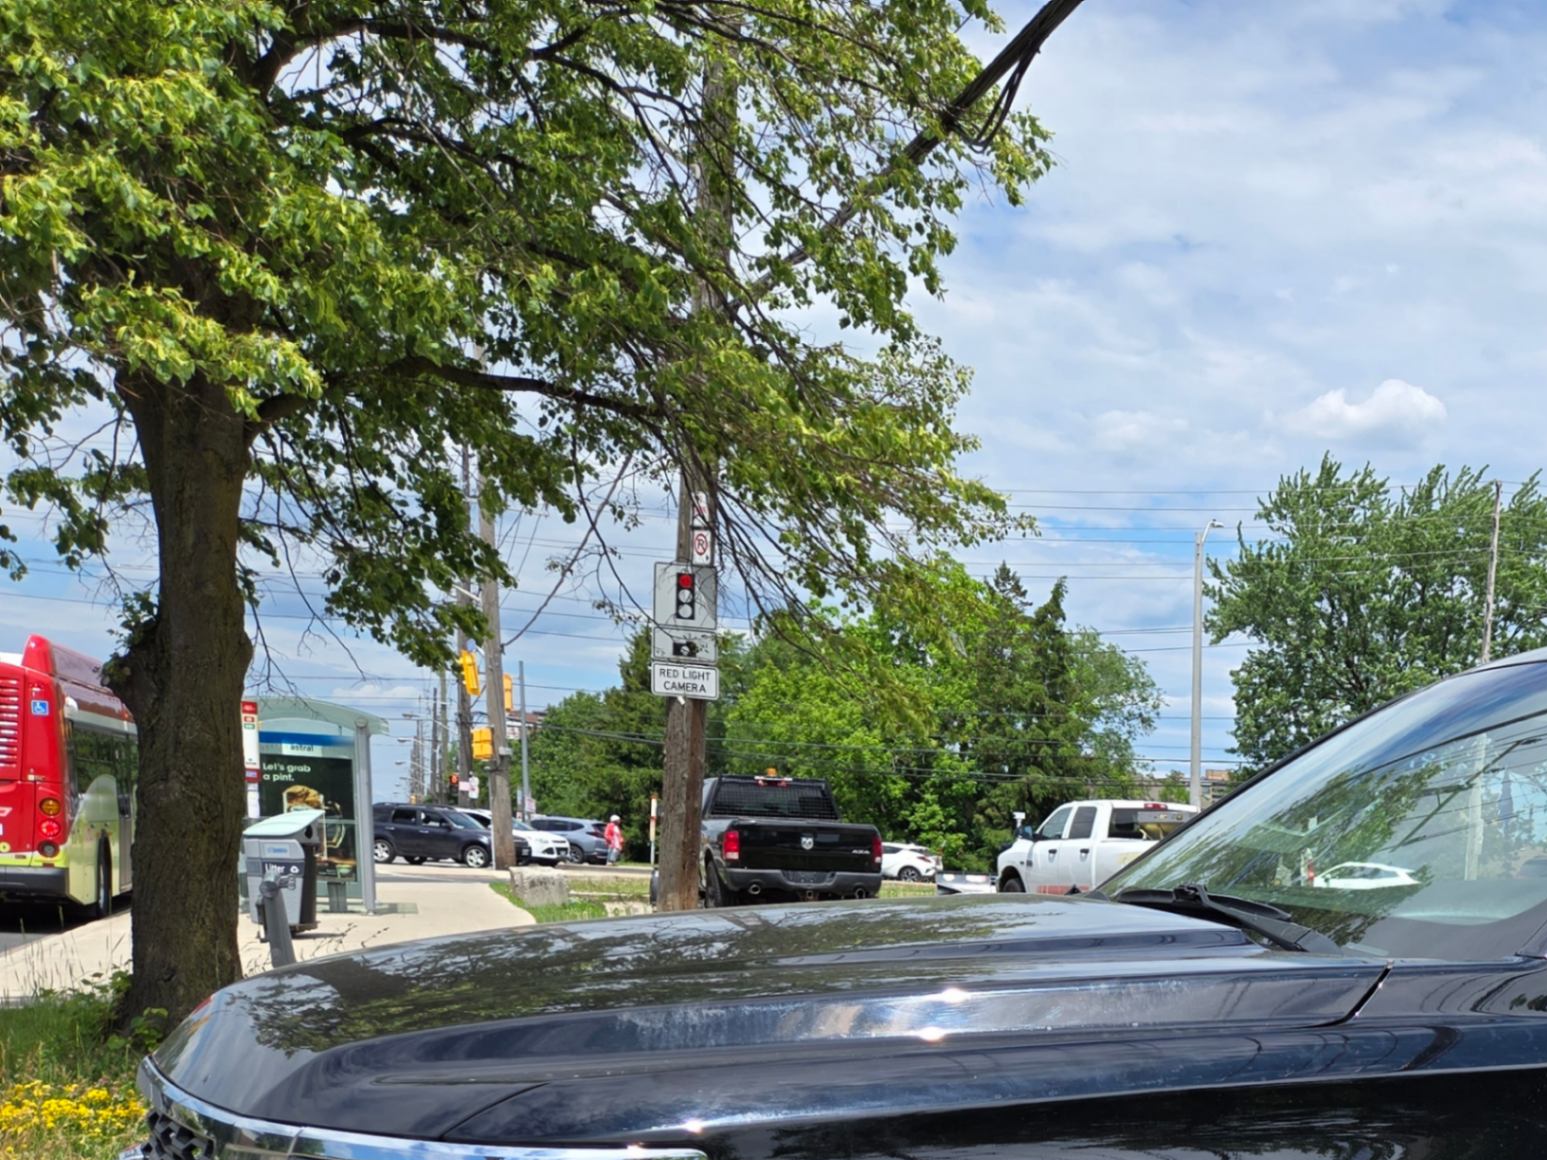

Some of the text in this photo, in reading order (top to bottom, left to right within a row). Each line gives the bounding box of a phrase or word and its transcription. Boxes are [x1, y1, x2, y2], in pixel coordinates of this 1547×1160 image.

[659, 668, 711, 681] RED LIGHT
[663, 681, 706, 693] CAMERA
[262, 763, 285, 771] Let's
[287, 765, 311, 774] grab
[272, 774, 295, 782] pint.
[265, 863, 285, 873] Litter
